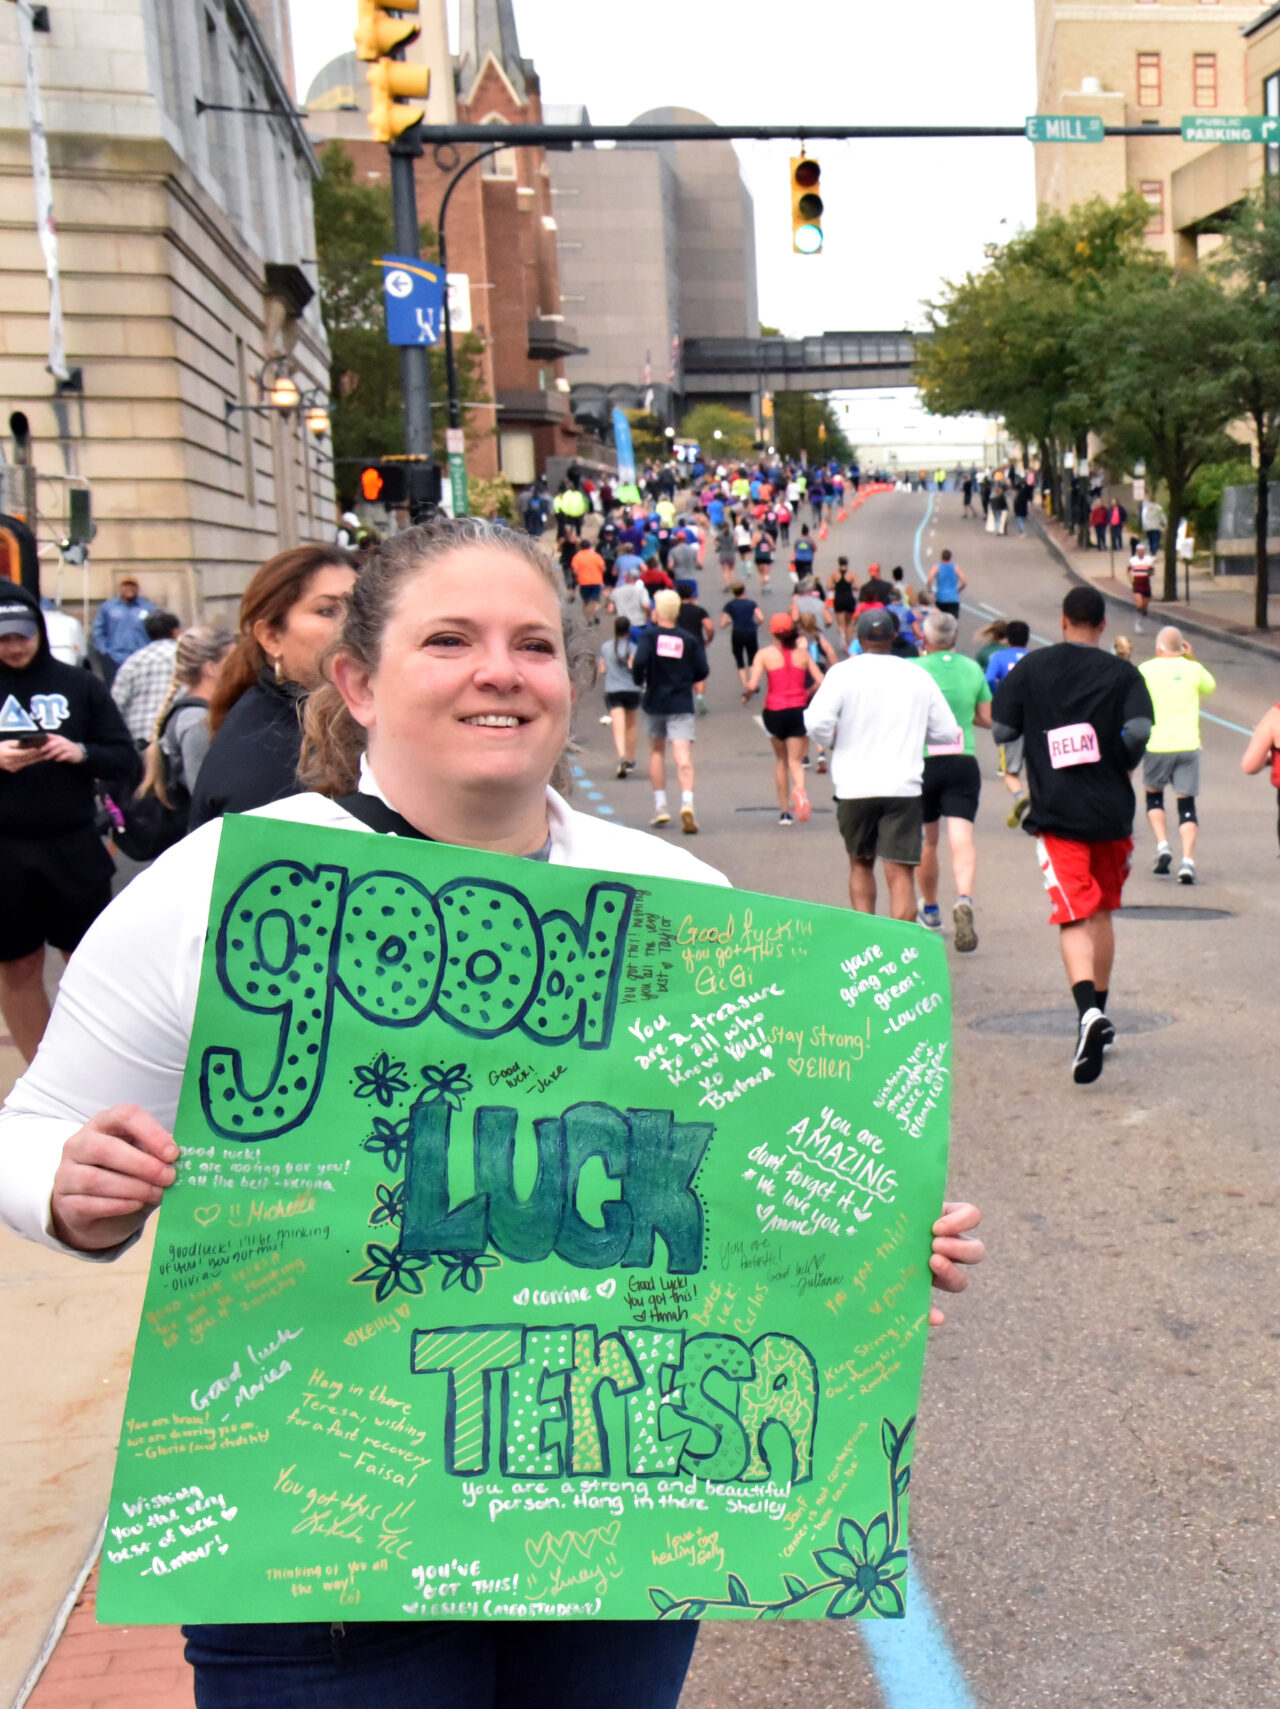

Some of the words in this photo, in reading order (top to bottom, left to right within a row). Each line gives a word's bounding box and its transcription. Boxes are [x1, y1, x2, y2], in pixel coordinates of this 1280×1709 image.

[1026, 118, 1039, 139] E
[1046, 118, 1087, 140] MILL
[1186, 127, 1252, 141] PARKING
[1051, 734, 1095, 757] RELAY
[675, 914, 735, 945] Good
[200, 859, 637, 1143] good
[628, 1014, 671, 1044] You
[489, 1061, 521, 1086] Good
[786, 1117, 899, 1194] AMAZING
[399, 1100, 715, 1275] LUCK
[785, 1162, 837, 1201] forget
[782, 1189, 811, 1215] love
[363, 1436, 432, 1471] recovery
[512, 1482, 548, 1494] are
[561, 1482, 576, 1493] a
[580, 1479, 649, 1499] strong
[657, 1475, 697, 1495] and
[705, 1480, 793, 1499] beautiful
[573, 1494, 624, 1516] Hang
[725, 1500, 788, 1520] Shelley
